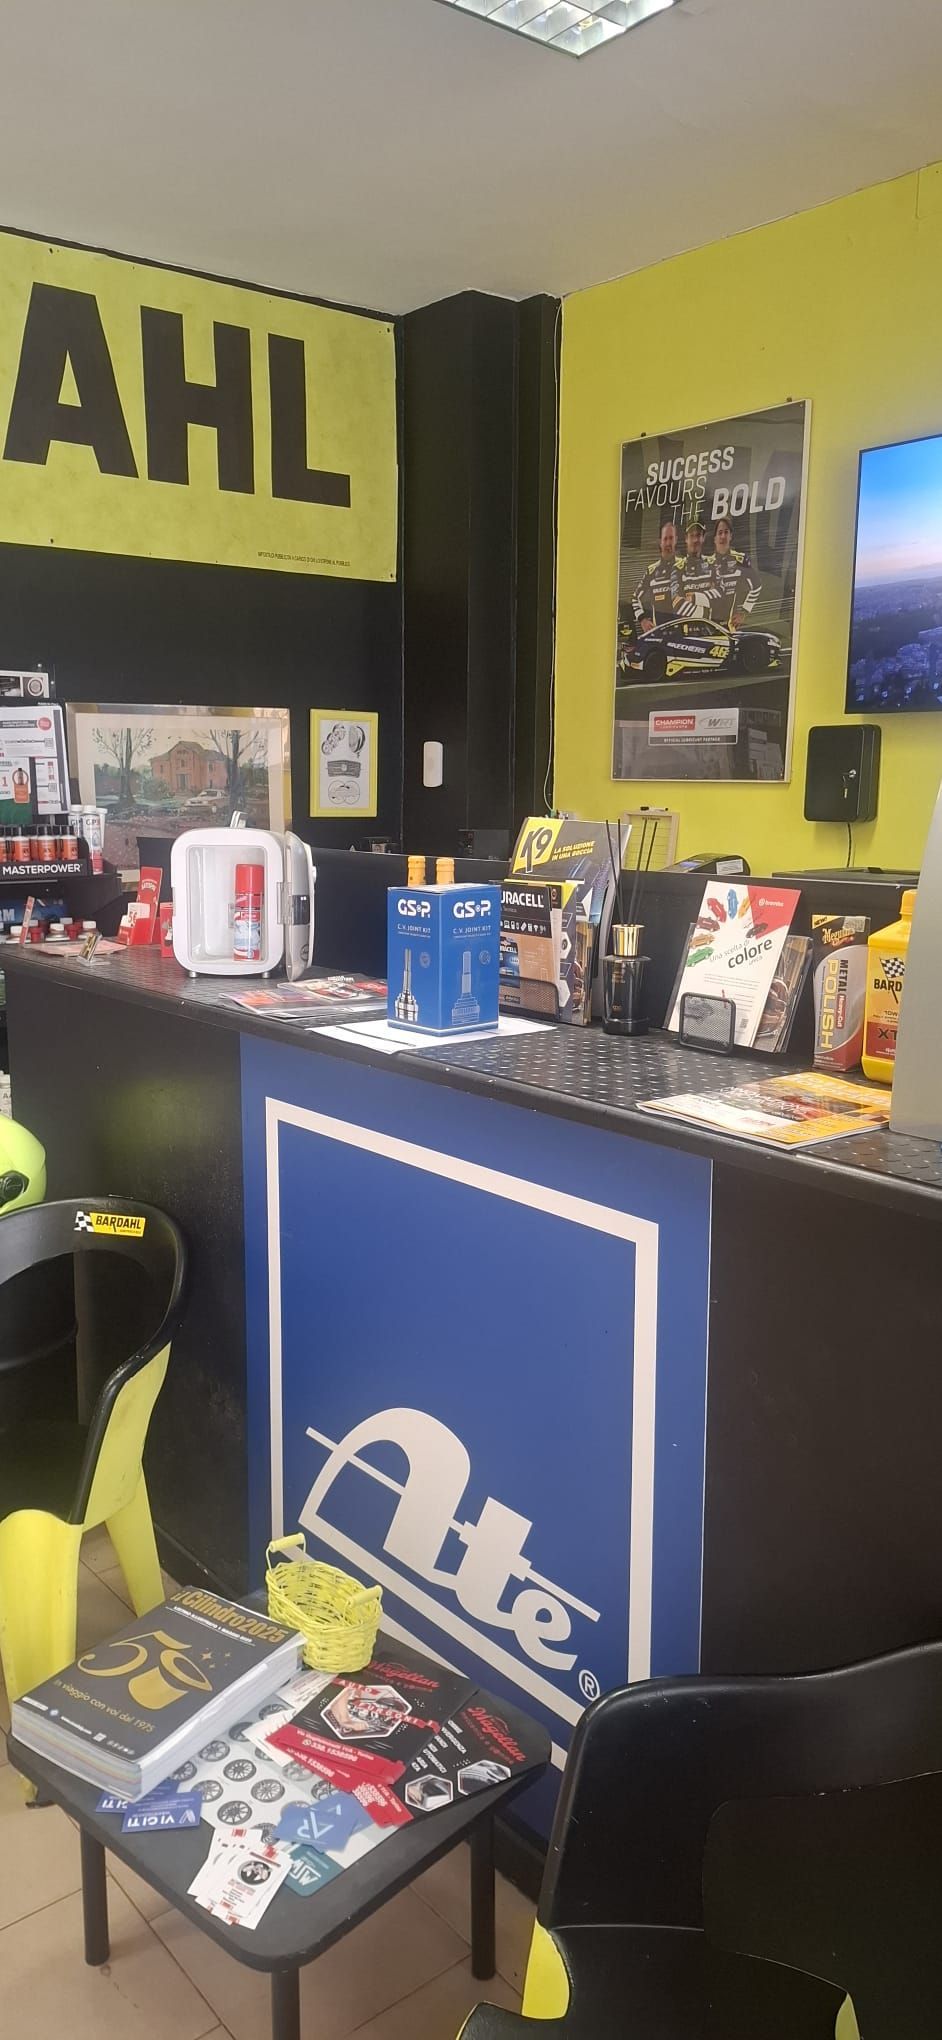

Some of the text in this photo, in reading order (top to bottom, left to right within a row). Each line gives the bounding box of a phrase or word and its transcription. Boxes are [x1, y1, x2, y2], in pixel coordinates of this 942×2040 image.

[646, 446, 735, 486] SUCCESS
[625, 476, 707, 513] FAVOURS
[671, 476, 786, 525] THE BOLD
[709, 645, 730, 659] 46
[655, 718, 694, 726] CHAMPION
[2, 863, 81, 876] MASTERPOWER
[407, 925, 422, 933] JOINT
[464, 926, 481, 934] JOINT
[728, 939, 772, 969] colore
[838, 959, 848, 992] METAL
[820, 959, 839, 1049] POLISH
[95, 1215, 142, 1232] BARDAHL
[297, 1407, 601, 1672] Ate
[62, 1682, 90, 1701] viaggio
[90, 1699, 106, 1710] con
[106, 1707, 120, 1716] voi
[119, 1713, 135, 1722] dal
[134, 1720, 155, 1733] 1975
[467, 1706, 527, 1763] Magellan
